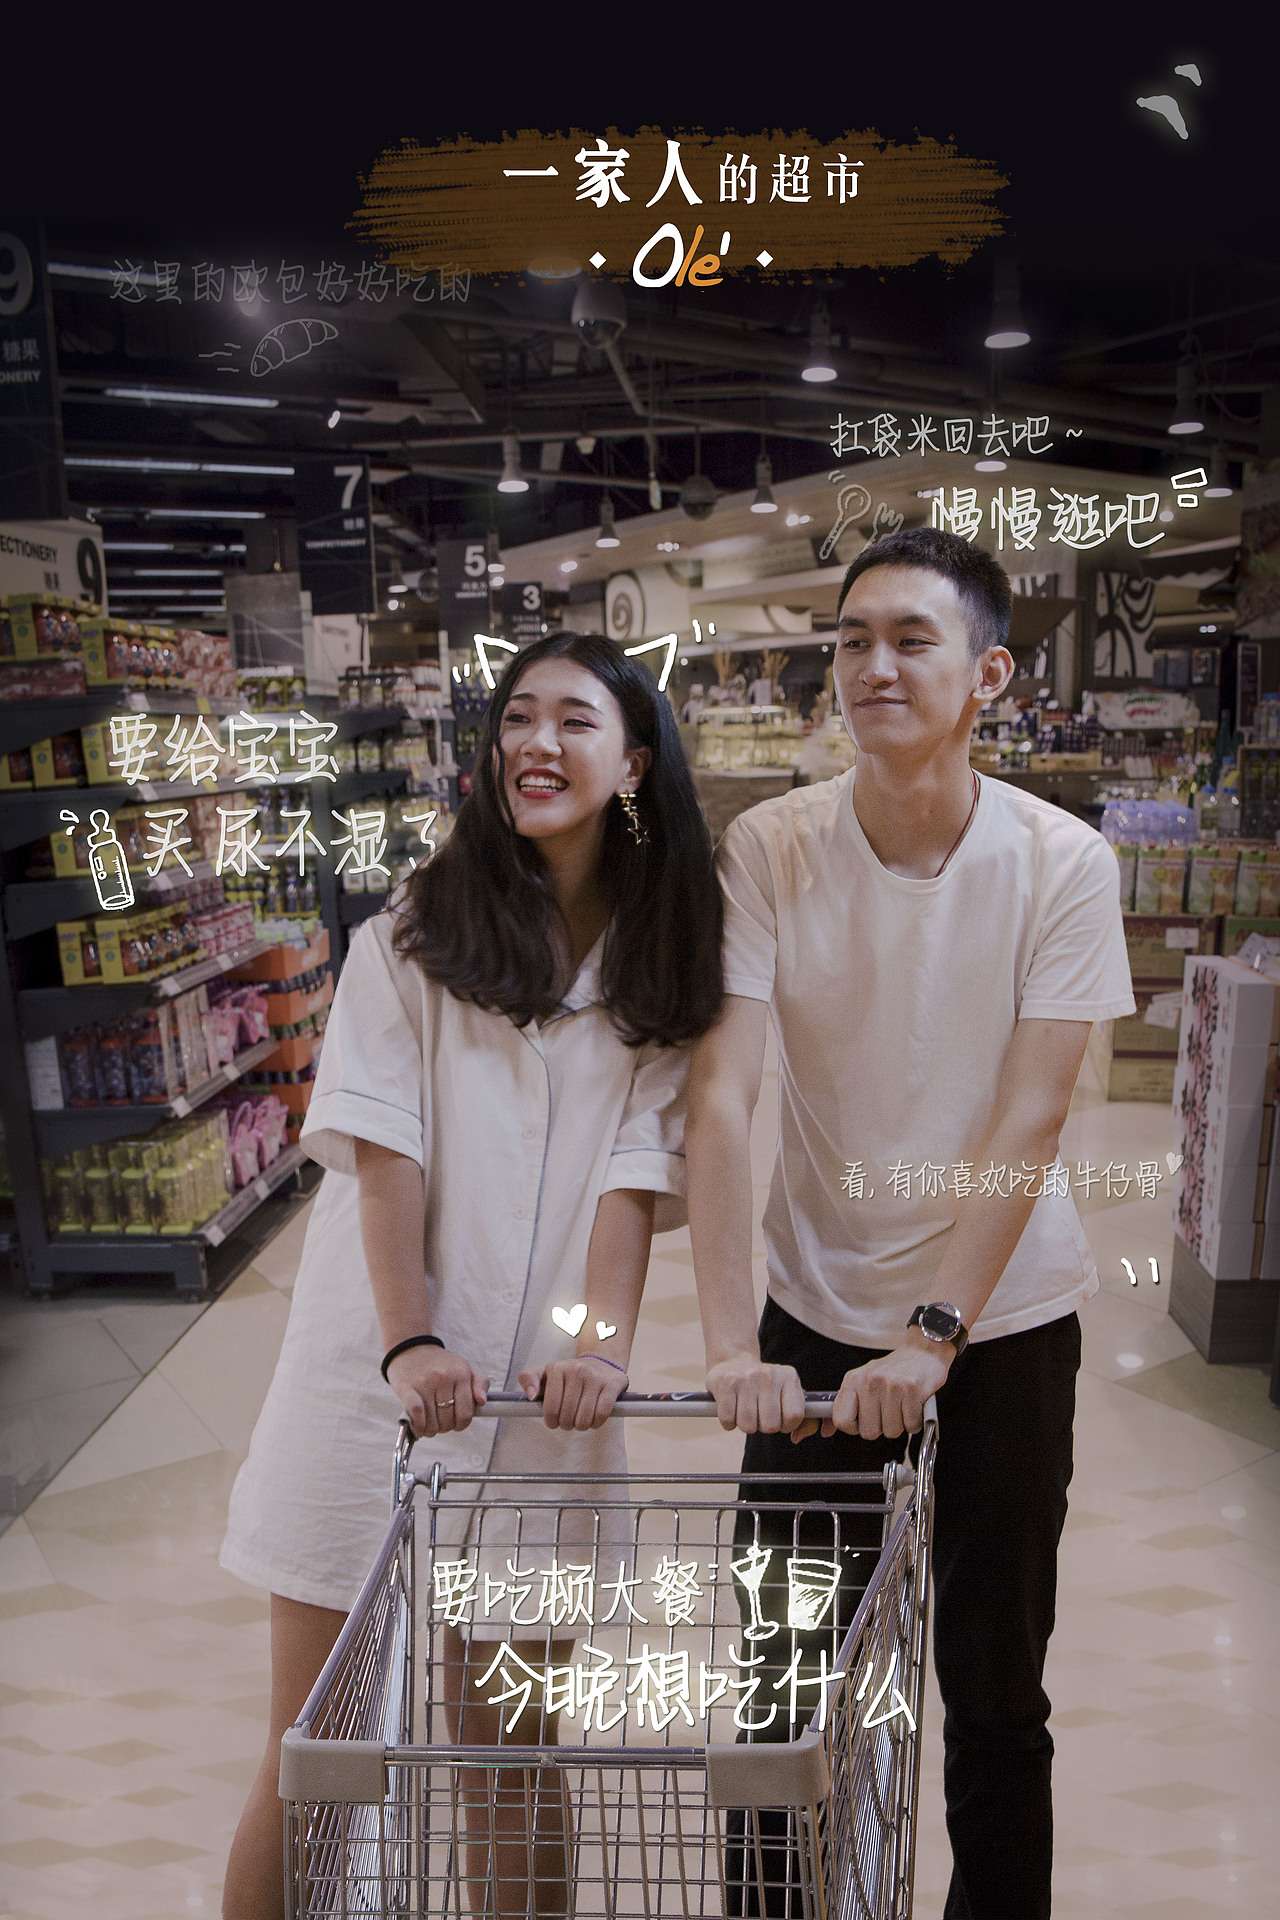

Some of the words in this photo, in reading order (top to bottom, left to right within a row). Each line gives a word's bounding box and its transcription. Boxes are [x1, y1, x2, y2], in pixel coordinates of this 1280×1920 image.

[0, 231, 34, 315] 9
[333, 465, 363, 510] 7
[77, 537, 102, 605] 9
[464, 545, 486, 577] 5
[522, 584, 541, 611] 3
